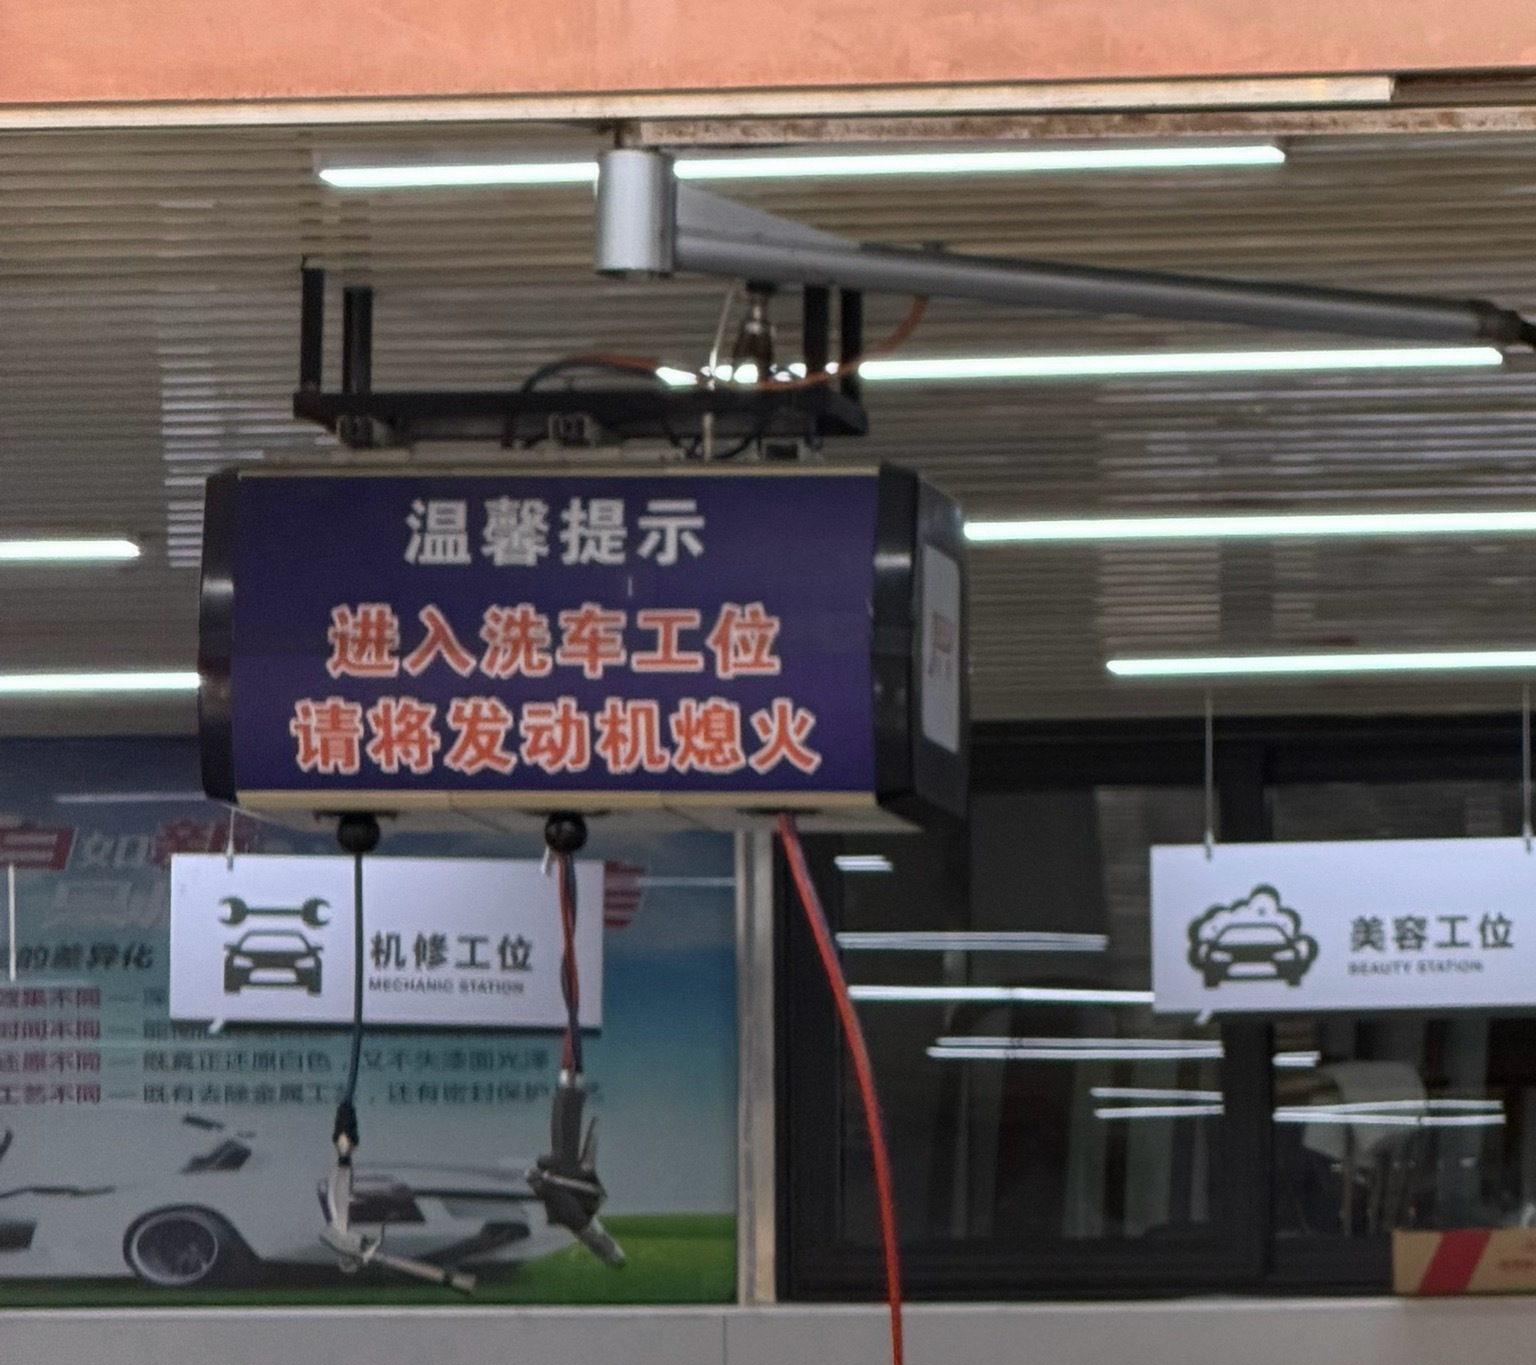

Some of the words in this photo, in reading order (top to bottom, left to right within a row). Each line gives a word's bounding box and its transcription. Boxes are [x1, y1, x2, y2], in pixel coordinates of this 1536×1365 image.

[405, 497, 706, 567] 温馨提示
[326, 602, 781, 681] 进入洗车工位
[289, 696, 822, 776] 请将发动机熄火
[370, 930, 534, 972] 机修工位
[1350, 912, 1514, 953] 美容工位
[0, 941, 153, 971] 的差异化
[1347, 959, 1411, 976] BEAUTY
[1416, 958, 1485, 975] STATION
[368, 977, 454, 994] MECHANIC
[459, 978, 526, 997] STATION
